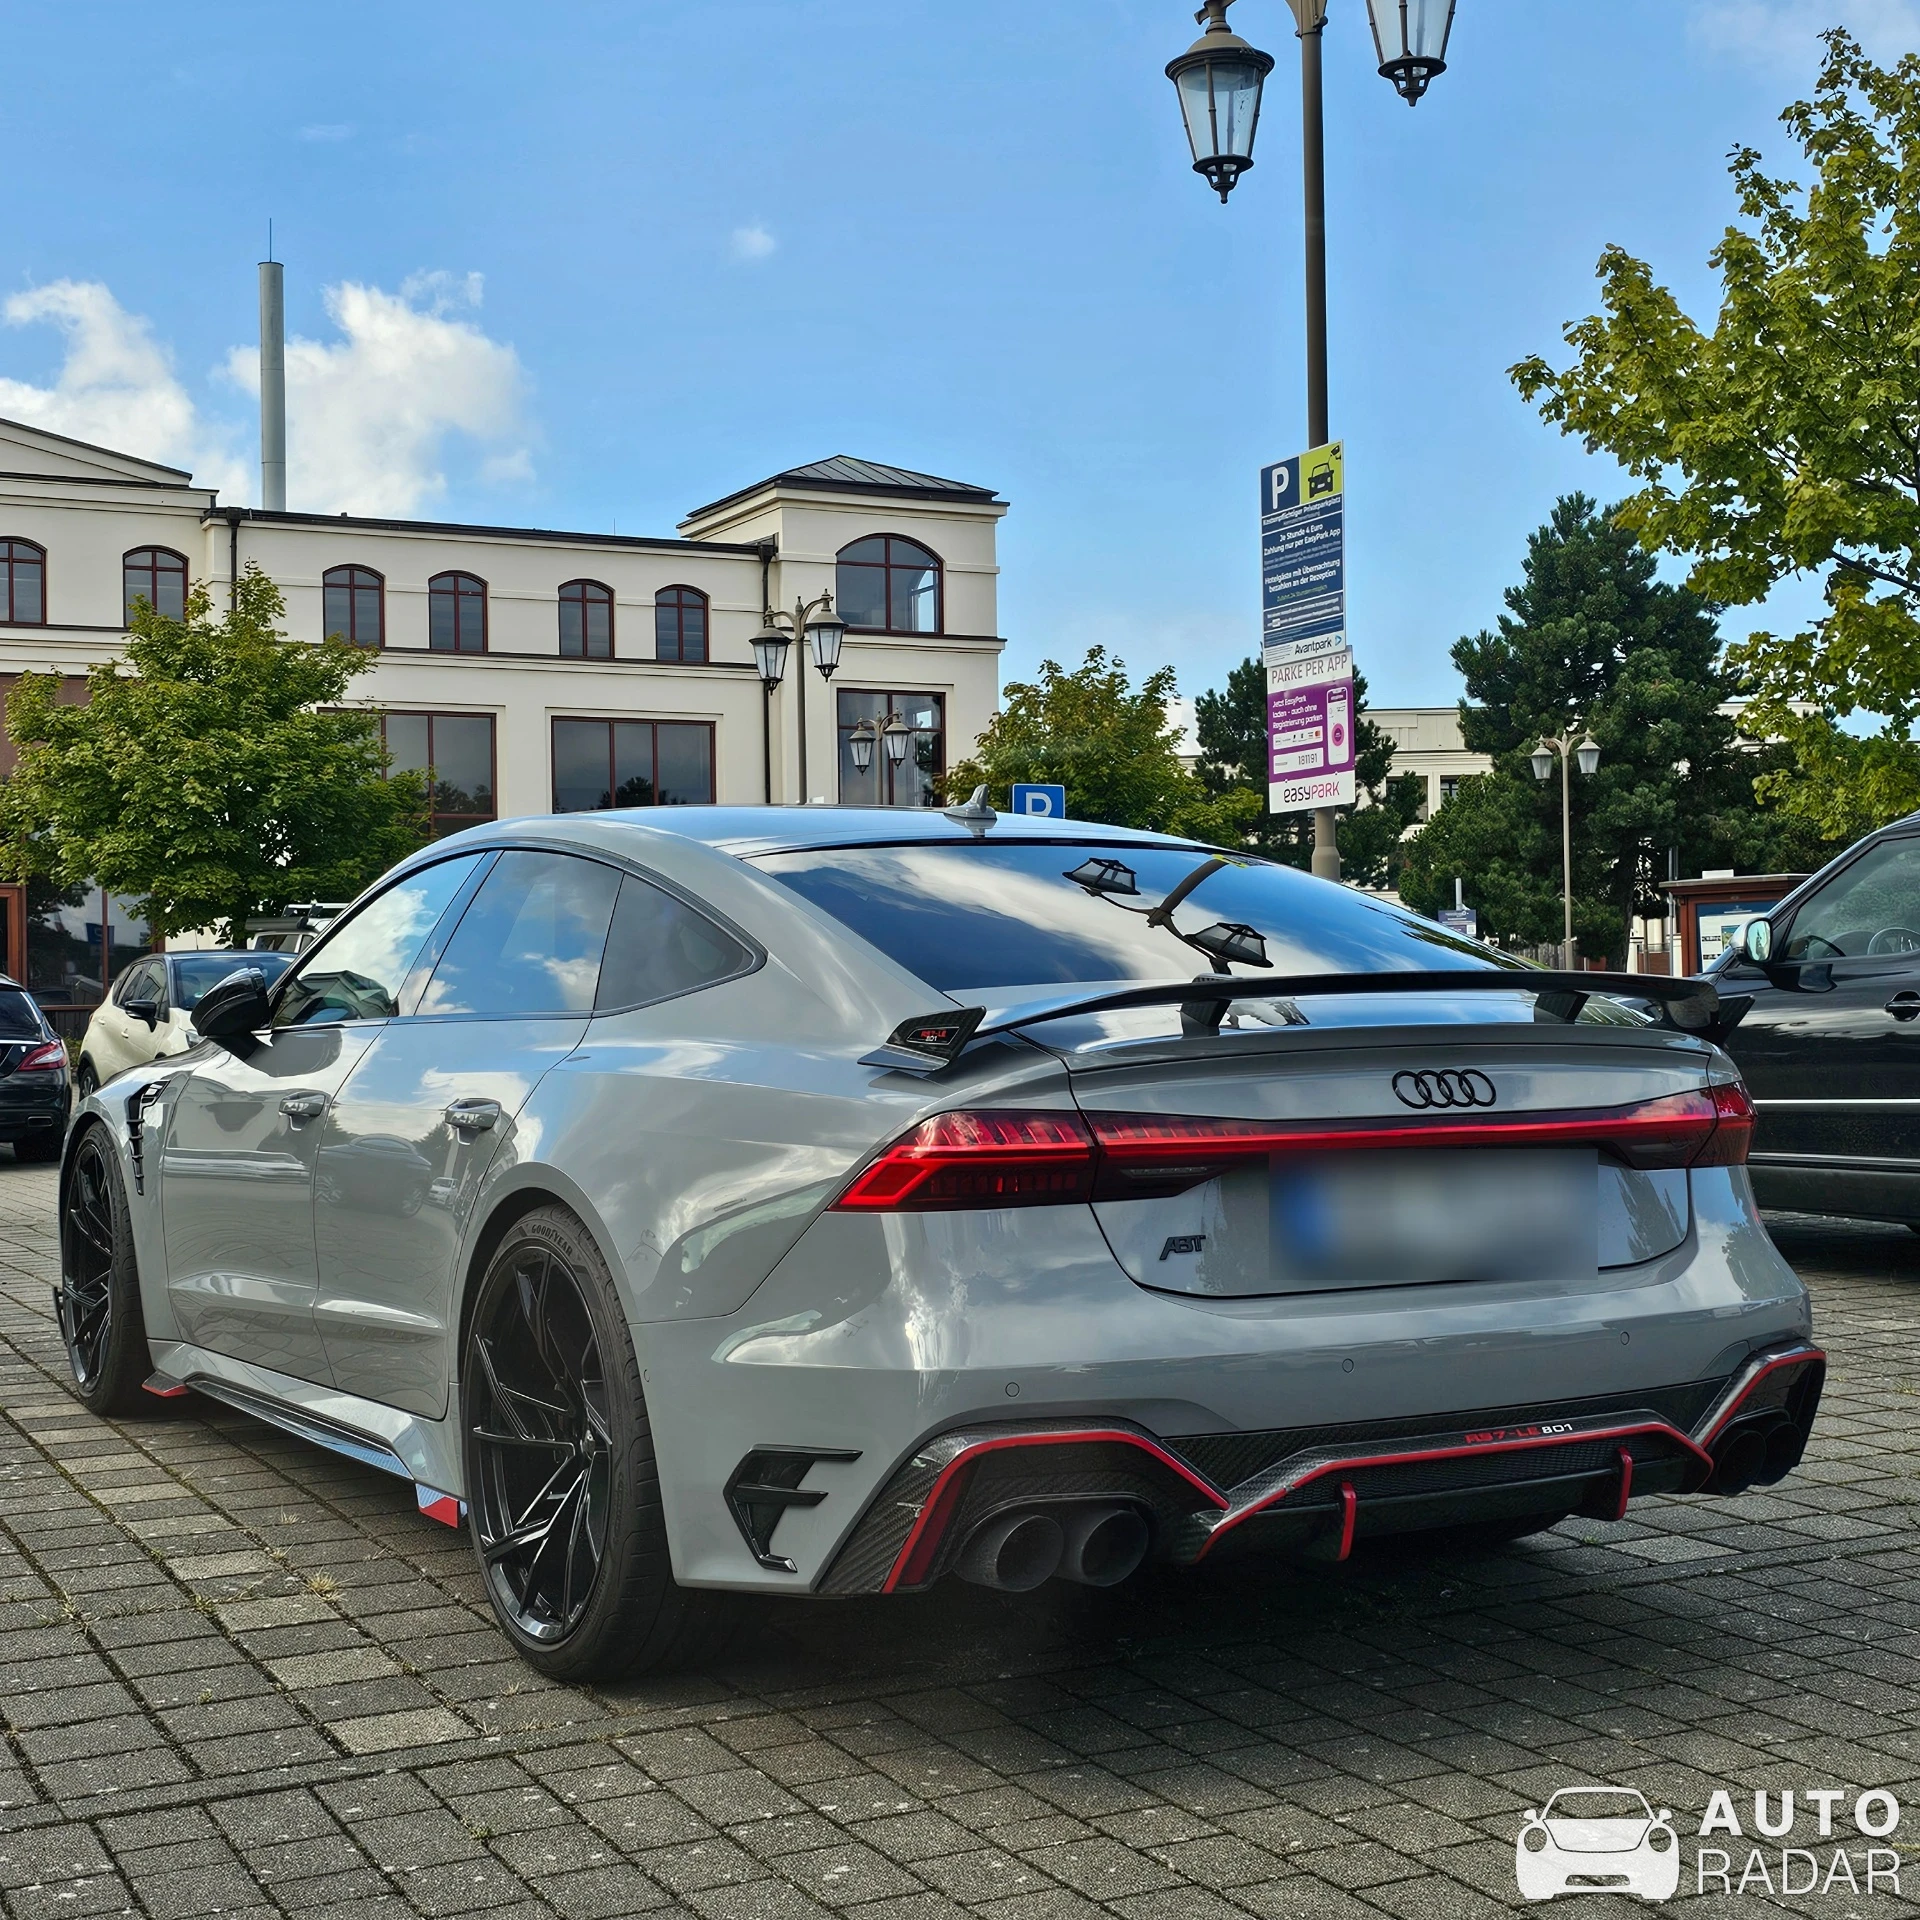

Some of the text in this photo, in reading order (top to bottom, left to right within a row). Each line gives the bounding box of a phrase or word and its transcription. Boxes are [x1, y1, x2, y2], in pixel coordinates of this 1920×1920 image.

[1273, 467, 1289, 508] P
[1264, 544, 1284, 555] Zahlung
[1295, 540, 1303, 548] per
[1305, 531, 1328, 543] EasyPark
[1330, 529, 1340, 537] App
[1287, 529, 1305, 539] Stunde
[1311, 524, 1323, 532] Euro
[1293, 567, 1301, 576] mit
[1303, 559, 1340, 574] Übernachtung
[1269, 570, 1336, 592] bezahlen an der Rezeption
[1295, 637, 1332, 654] Avantpark
[1272, 654, 1347, 684] PARKE PER APP
[1285, 695, 1306, 705] EasyPark
[1273, 715, 1322, 729] Registrierung parken
[532, 1225, 572, 1256] GOODYEAR
[1160, 1235, 1206, 1260] ABT
